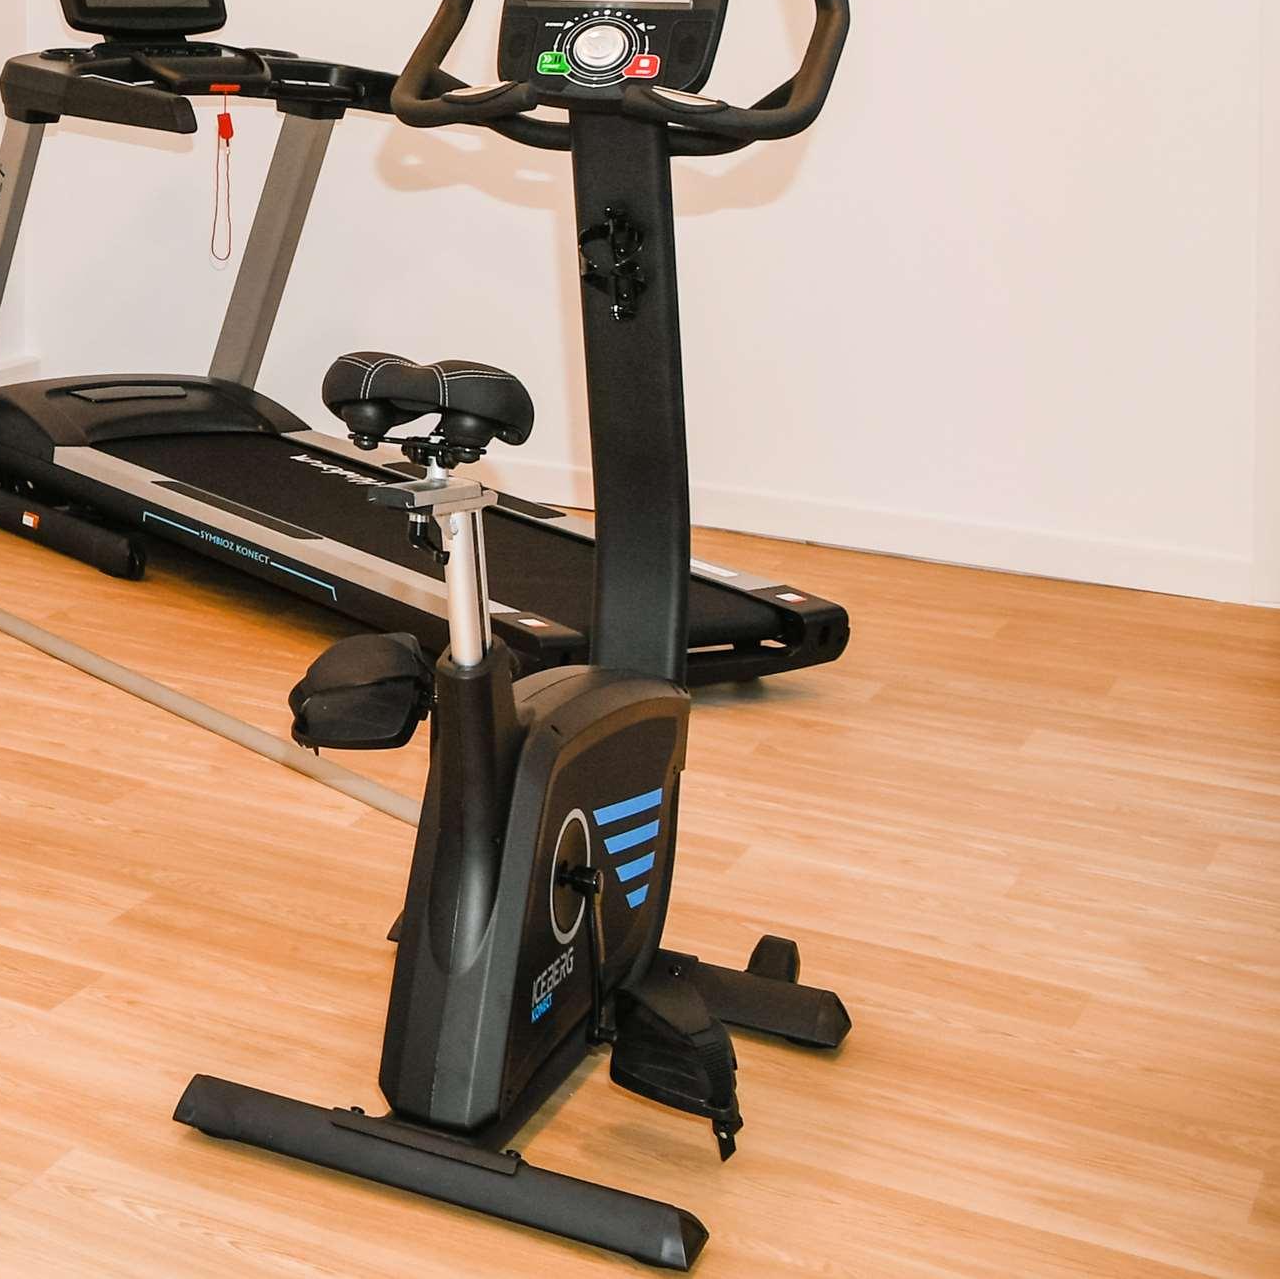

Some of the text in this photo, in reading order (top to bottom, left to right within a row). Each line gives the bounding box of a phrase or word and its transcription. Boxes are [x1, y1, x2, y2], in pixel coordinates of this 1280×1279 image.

[200, 530, 270, 564] SYMBIOZ KONECT
[532, 946, 574, 1008] ICEBERG
